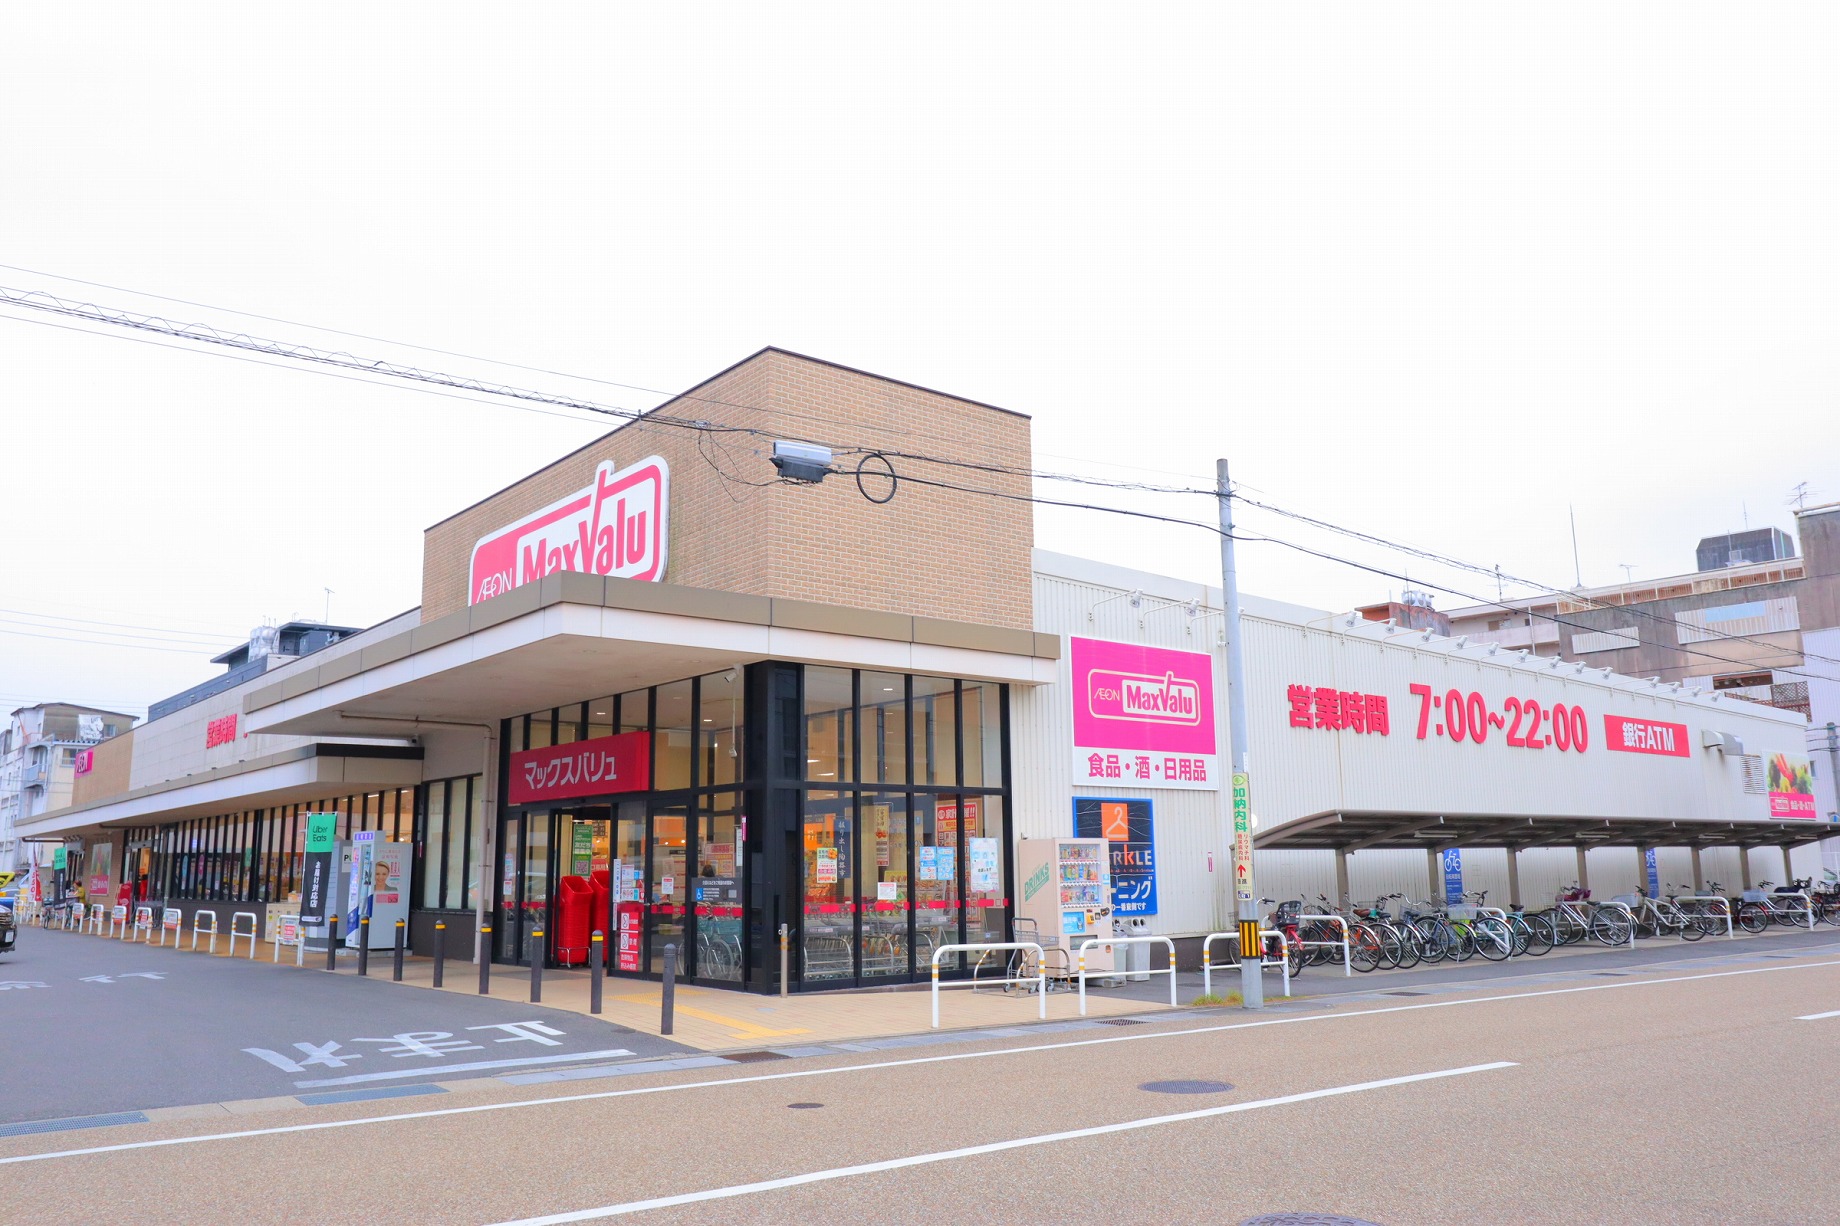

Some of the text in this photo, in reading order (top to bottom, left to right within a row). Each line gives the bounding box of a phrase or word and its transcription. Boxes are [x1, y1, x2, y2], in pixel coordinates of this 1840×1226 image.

[523, 468, 647, 583] MaxValu
[1126, 672, 1194, 715] MaxValu
[1287, 684, 1390, 737] 営業時間
[1622, 721, 1676, 752] 銀行ATM
[524, 751, 618, 790] マックスバリュ
[1087, 752, 1207, 783] 食品・酒・日用品
[1233, 787, 1248, 832] 加納内科
[312, 825, 328, 834] Uber
[312, 834, 328, 842] Eats
[1109, 844, 1153, 866] RkLE
